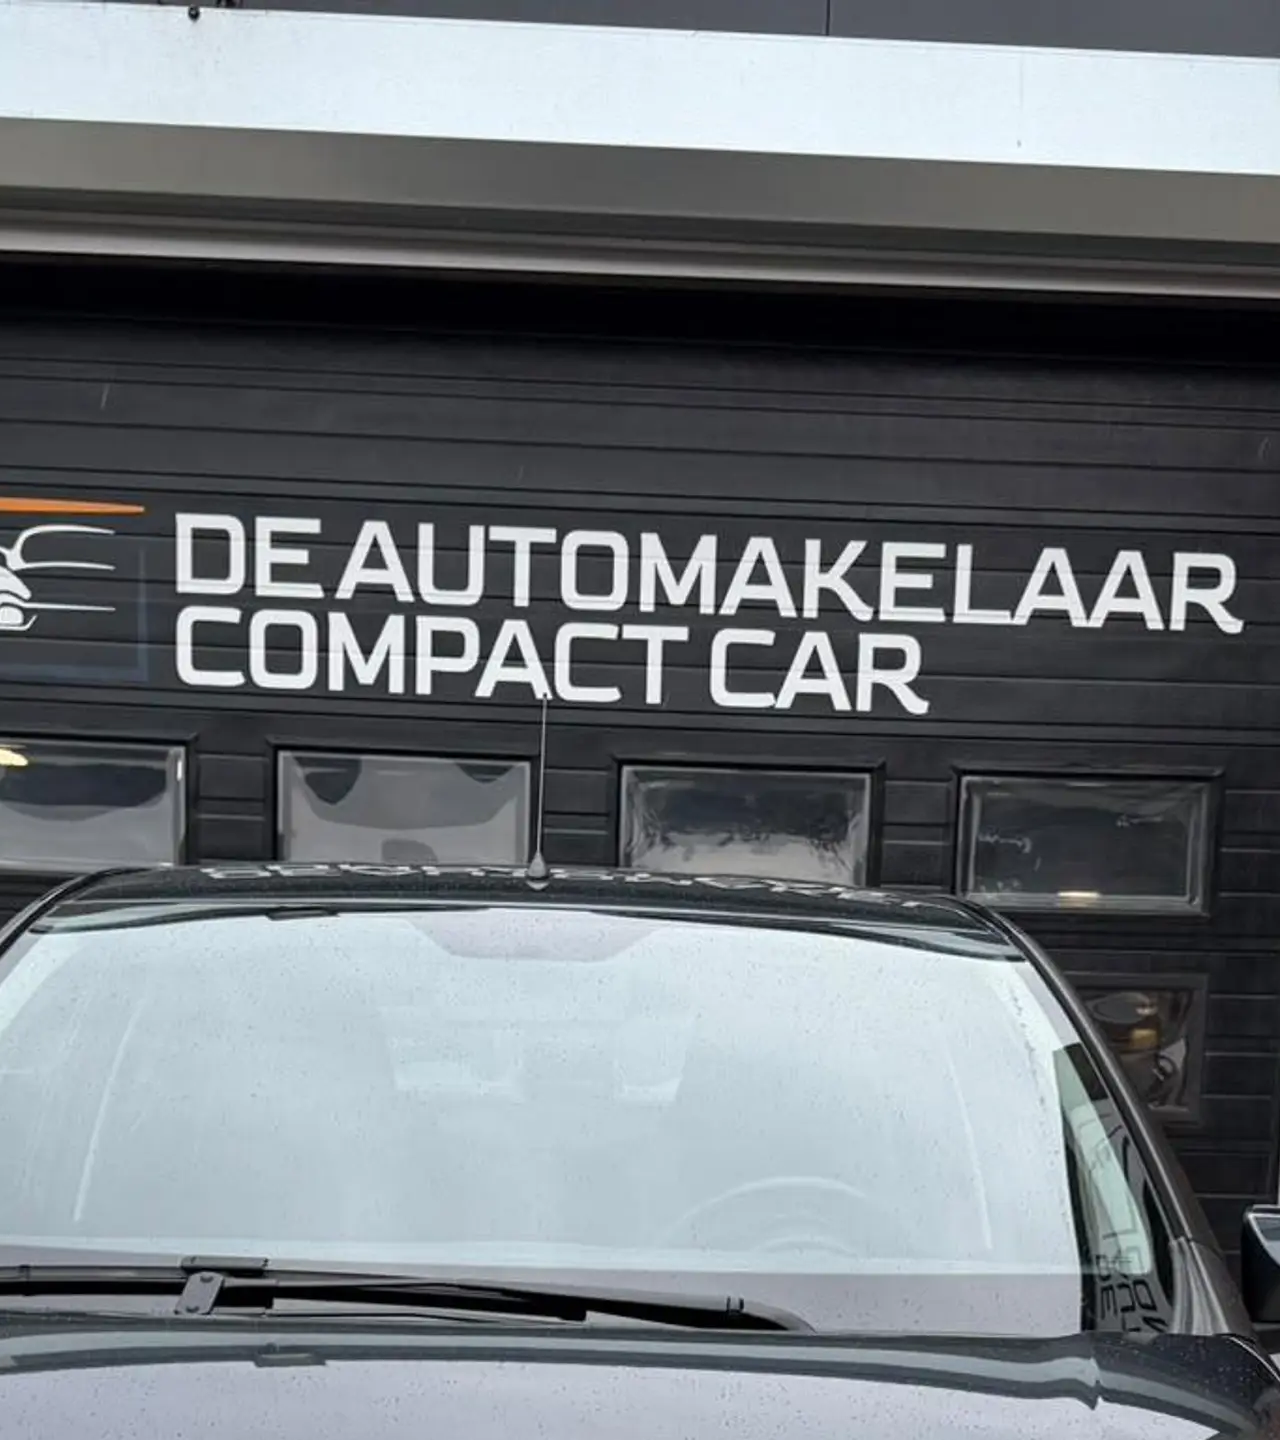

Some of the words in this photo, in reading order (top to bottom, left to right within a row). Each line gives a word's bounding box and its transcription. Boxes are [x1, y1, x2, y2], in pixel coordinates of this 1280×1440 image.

[175, 512, 325, 598] DE
[335, 520, 1244, 635] AUTOMAKELAAR
[175, 606, 689, 704] COMPACT
[710, 629, 930, 715] CAR
